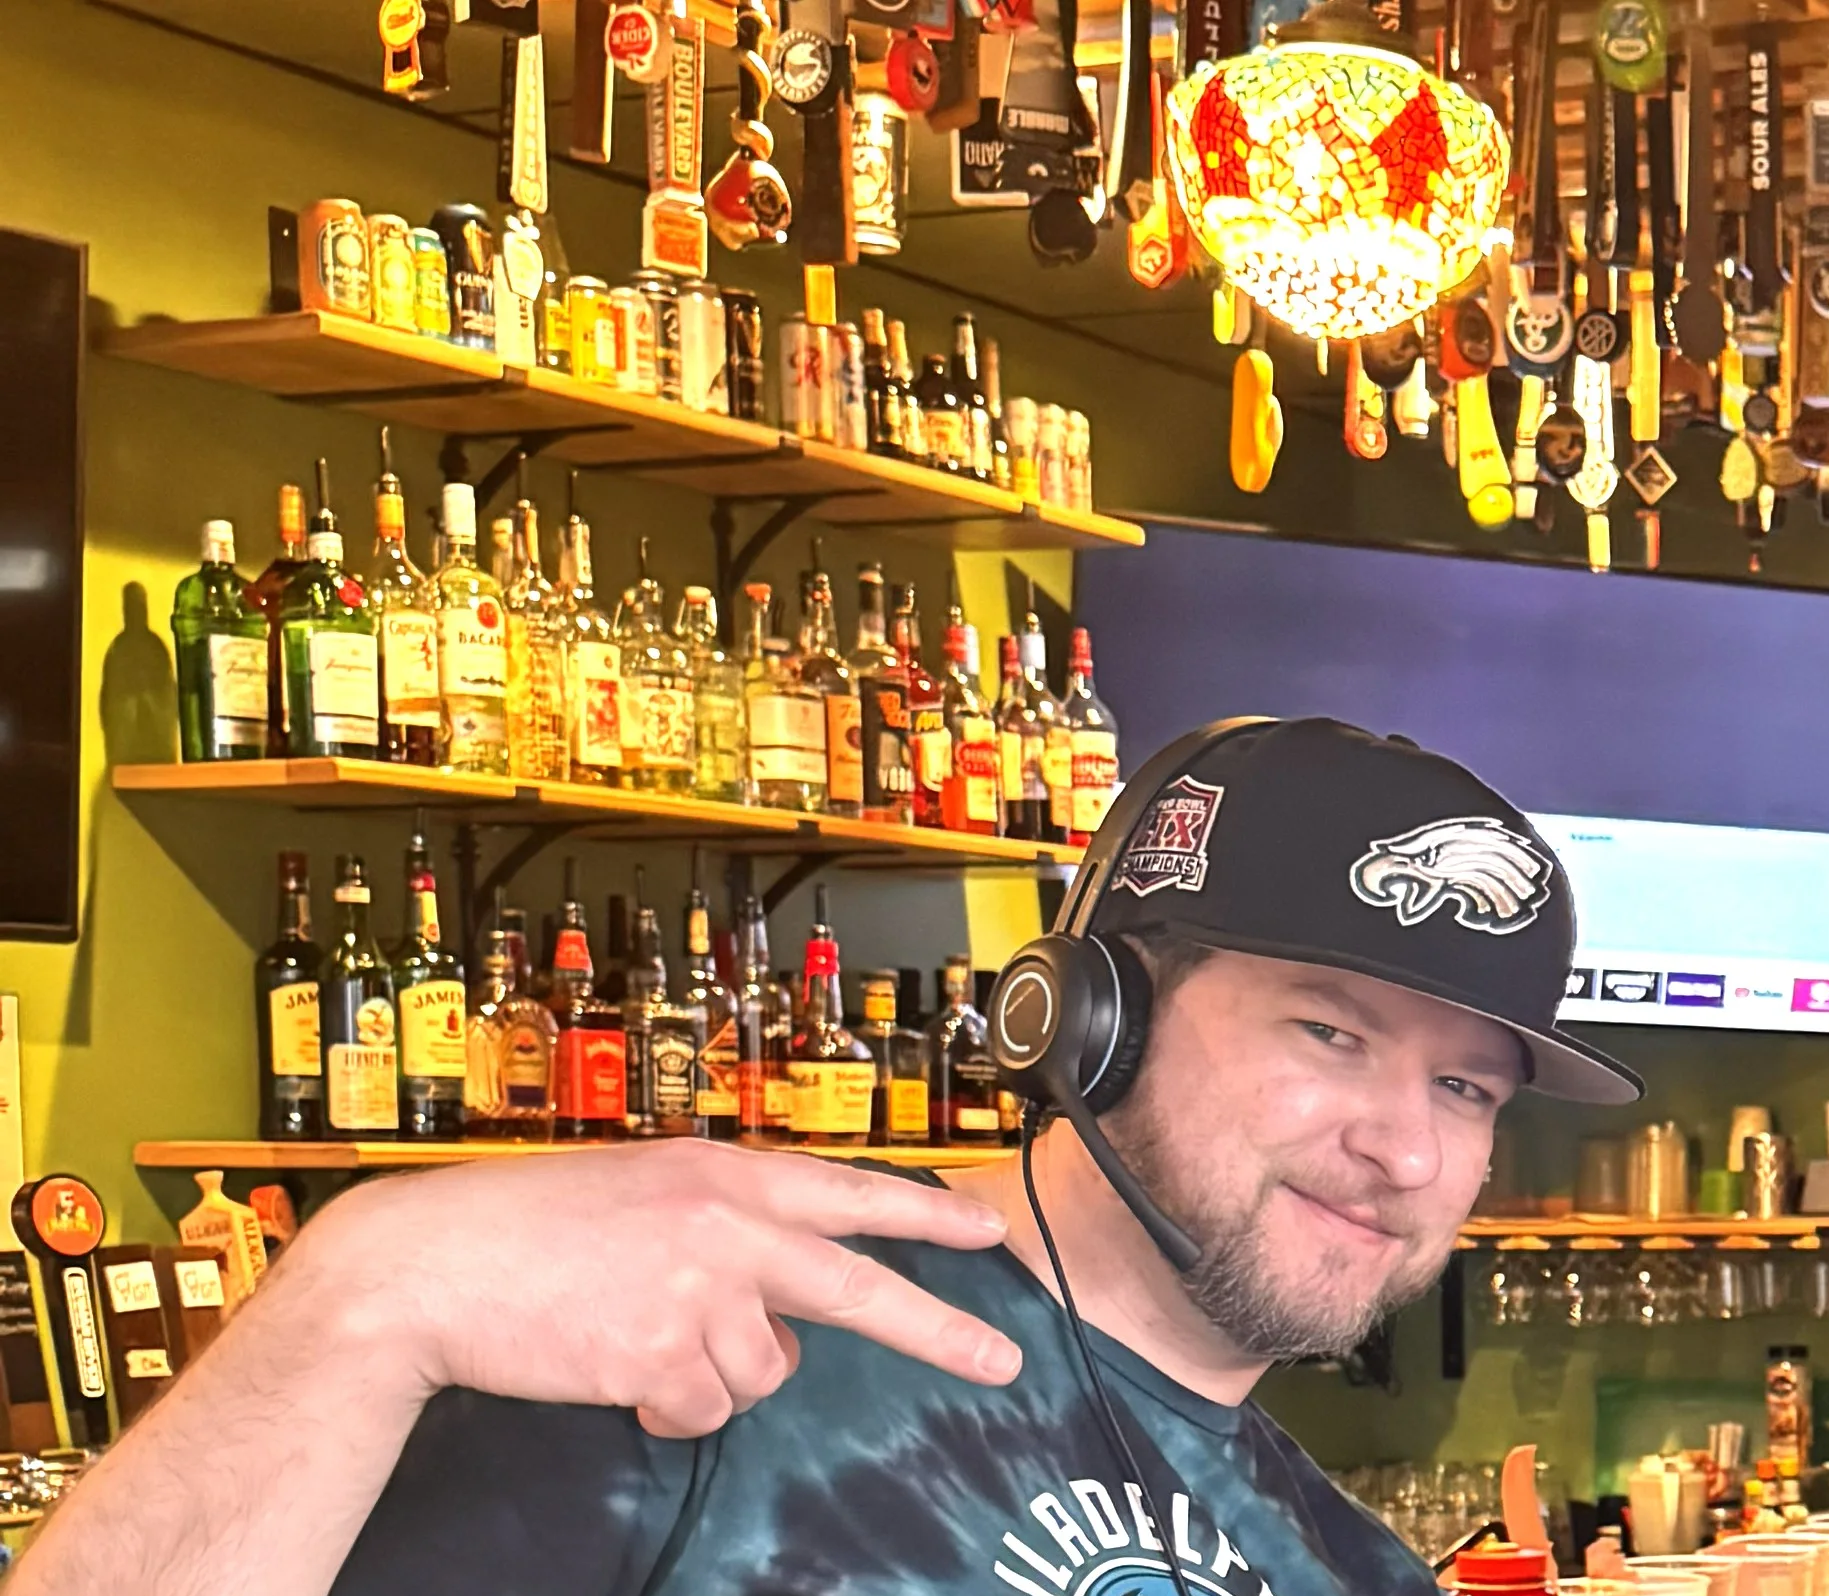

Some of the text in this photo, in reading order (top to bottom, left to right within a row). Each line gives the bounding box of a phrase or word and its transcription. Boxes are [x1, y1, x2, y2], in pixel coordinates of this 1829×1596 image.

[673, 43, 695, 175] BOULEVARD
[1750, 51, 1770, 191] SOUR ALES
